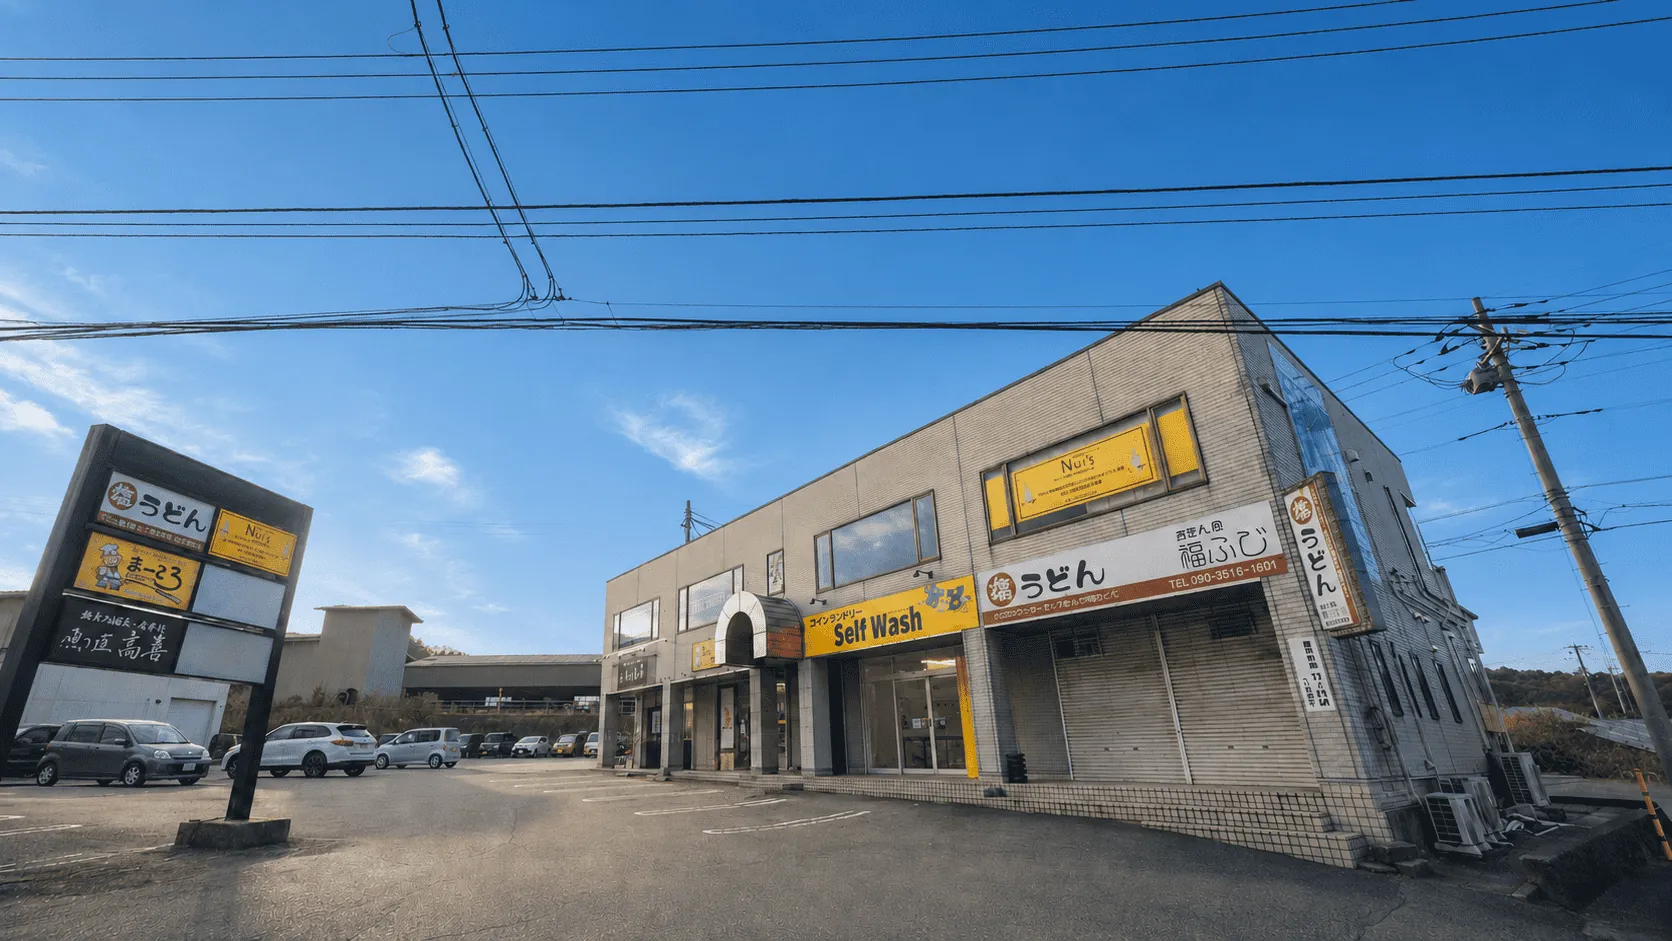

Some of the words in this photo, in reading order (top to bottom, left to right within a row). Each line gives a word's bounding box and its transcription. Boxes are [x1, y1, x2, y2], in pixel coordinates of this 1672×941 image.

[139, 493, 207, 533] うどん
[1021, 560, 1105, 599] うどん
[1300, 528, 1337, 597] うどん
[1168, 577, 1190, 589] TEL
[834, 616, 867, 647] Self
[870, 605, 923, 639] Wash
